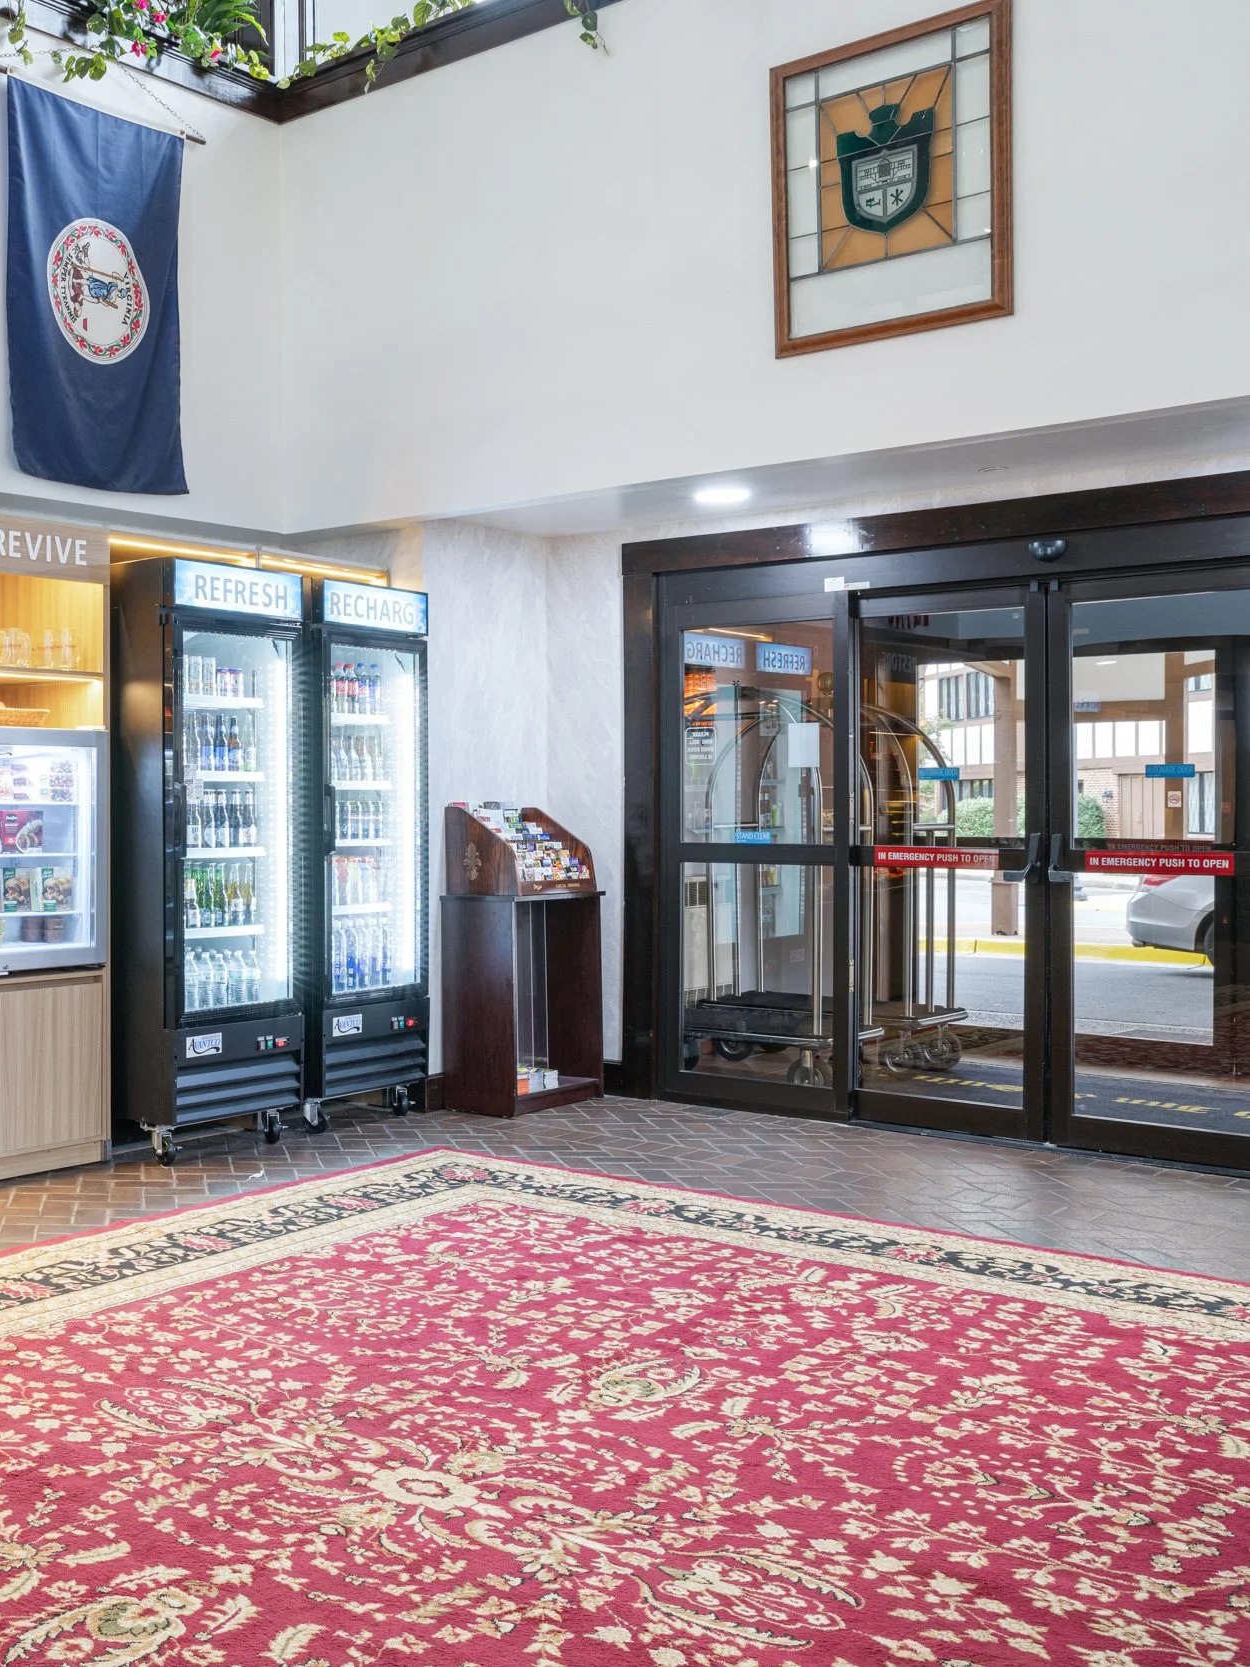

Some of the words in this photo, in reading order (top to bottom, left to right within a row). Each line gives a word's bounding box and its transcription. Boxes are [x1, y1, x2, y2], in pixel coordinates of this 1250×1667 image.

[61, 253, 73, 282] SEMPER
[61, 285, 77, 323] TYRANNIS
[121, 271, 133, 326] VIRGINIA
[194, 574, 288, 610] REFRESH
[736, 832, 753, 840] STAND
[754, 832, 770, 840] CLEAR
[878, 852, 886, 860] IN
[888, 852, 934, 861] EMERGENCY
[936, 853, 958, 862] PUSH
[960, 854, 971, 863] TO
[973, 854, 995, 863] OPEN
[1089, 857, 1099, 866] IN
[1101, 857, 1156, 867] EMERGENCY
[1159, 858, 1185, 867] PUSH
[1187, 859, 1200, 868] TO
[1202, 859, 1229, 869] OPEN
